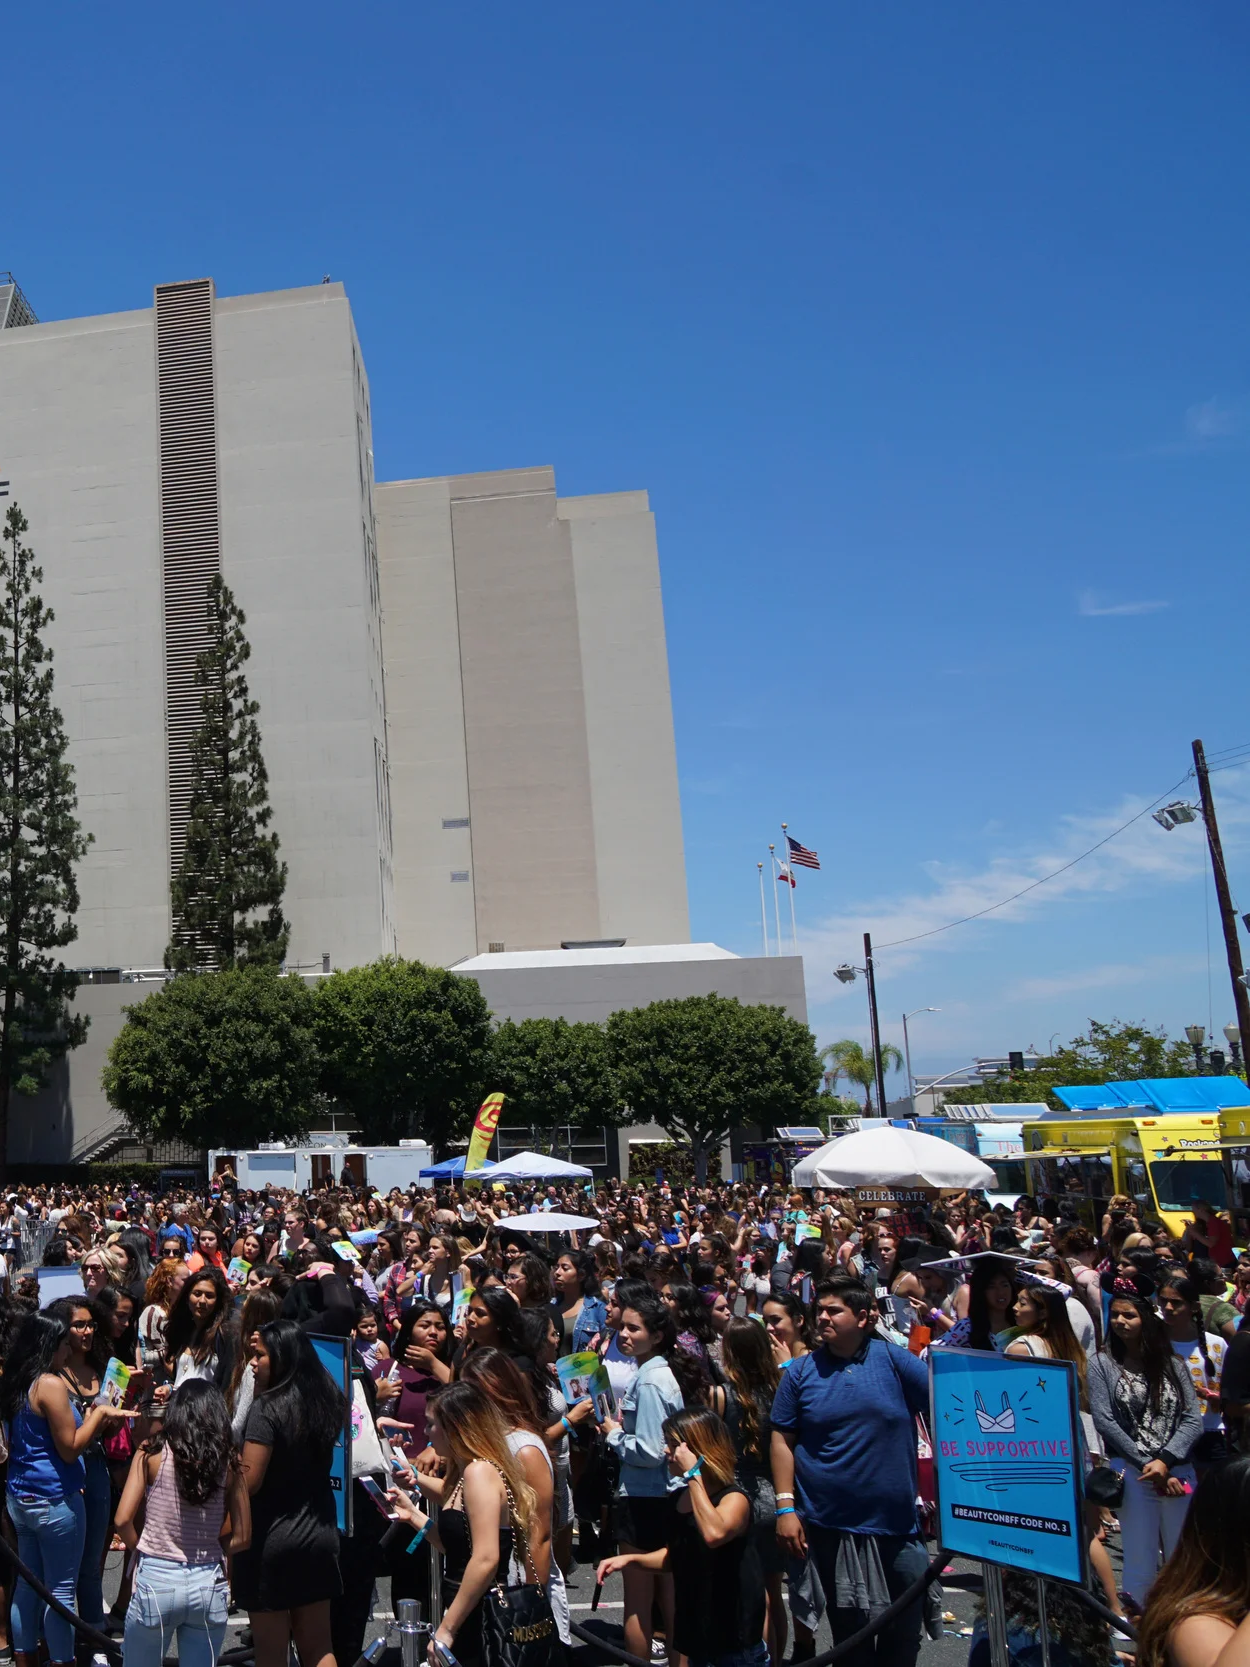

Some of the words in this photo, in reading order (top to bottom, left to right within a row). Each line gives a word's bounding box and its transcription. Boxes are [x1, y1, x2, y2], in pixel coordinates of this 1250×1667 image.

[996, 1141, 1021, 1153] The
[858, 1191, 926, 1201] CELEBRATE
[940, 1440, 960, 1457] BE
[966, 1440, 1070, 1457] SUPPORTIVE
[954, 1507, 1019, 1524] #BEAUTYCONBFF
[1020, 1517, 1043, 1529] CODE
[1045, 1522, 1060, 1531] NO.
[1062, 1524, 1067, 1532] 3
[988, 1540, 1034, 1555] #BEAUTYCONBFF
